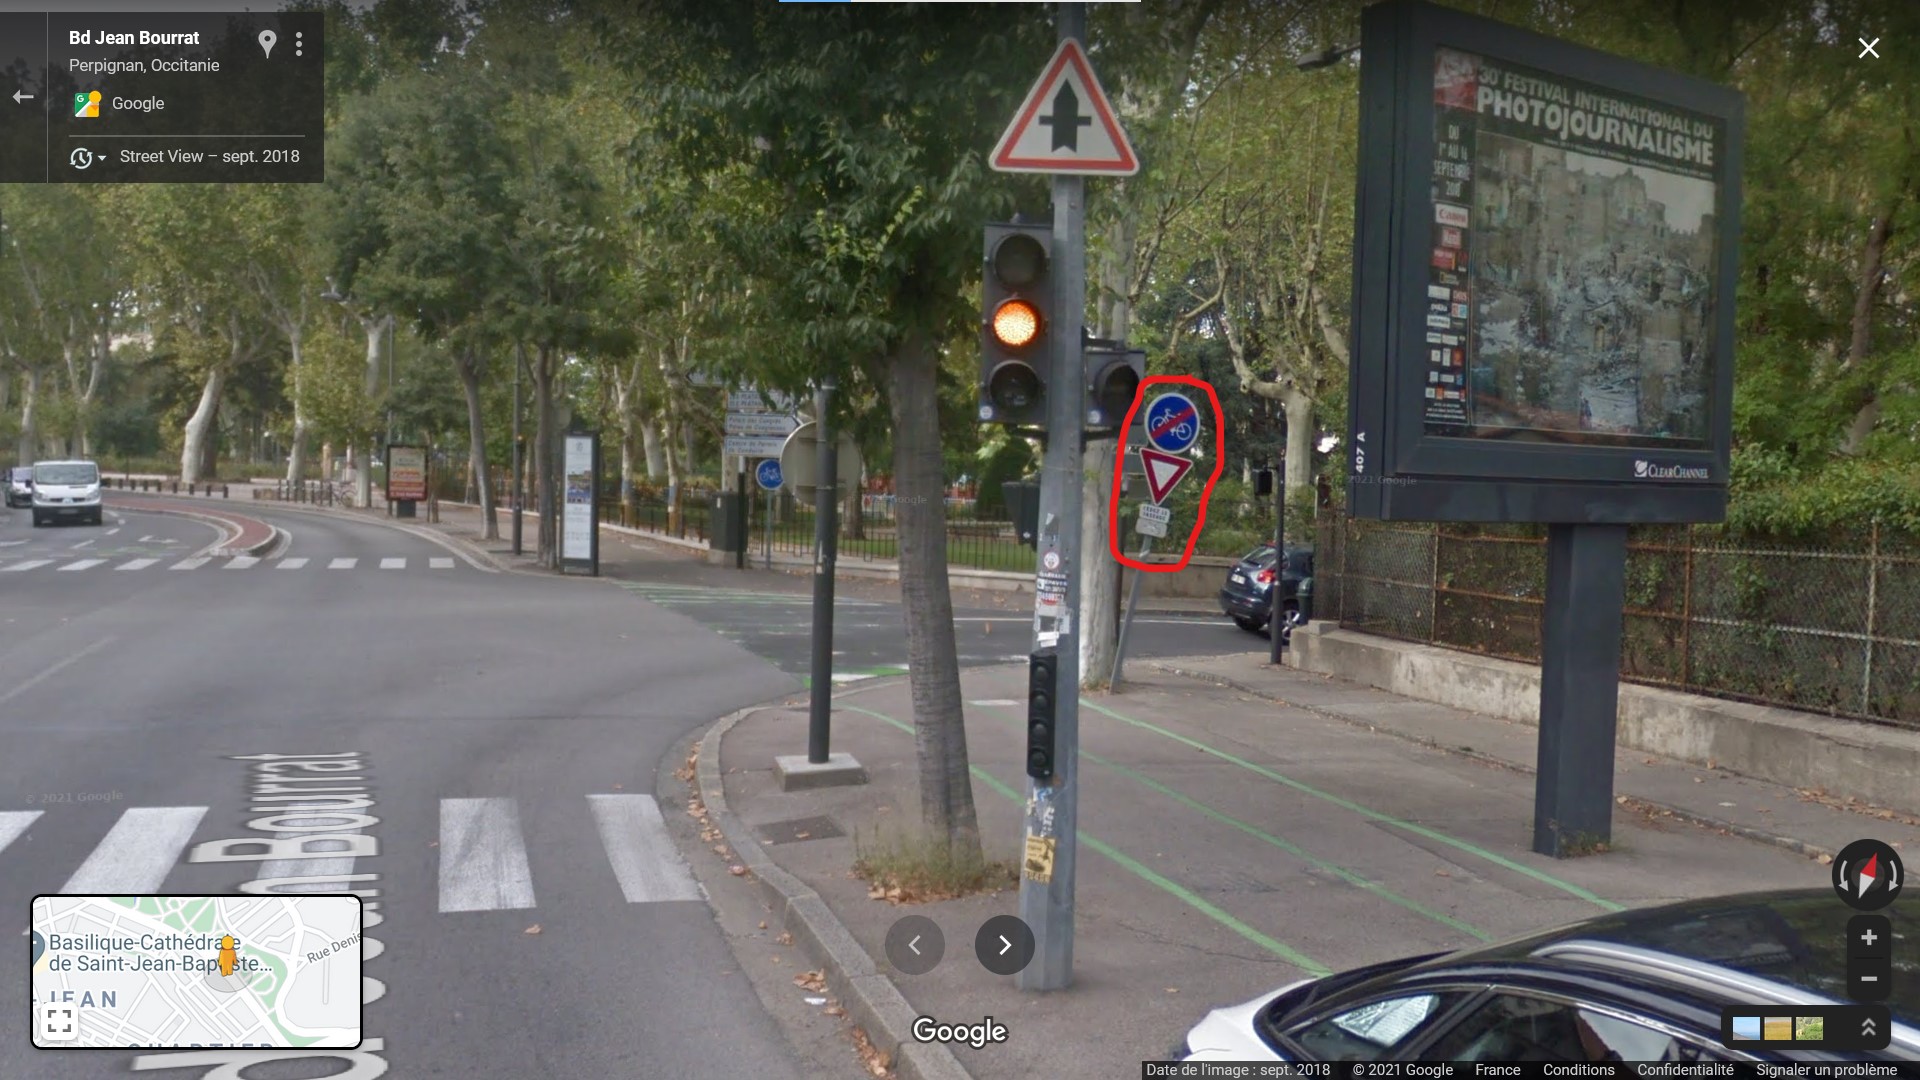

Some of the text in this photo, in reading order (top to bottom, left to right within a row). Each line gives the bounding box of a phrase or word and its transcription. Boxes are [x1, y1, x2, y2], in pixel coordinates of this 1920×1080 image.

[1504, 71, 1571, 105] FESTIVAL
[1574, 90, 1691, 135] INTERNATIONAL
[1693, 122, 1713, 140] DU
[1356, 432, 1365, 473] 407 A
